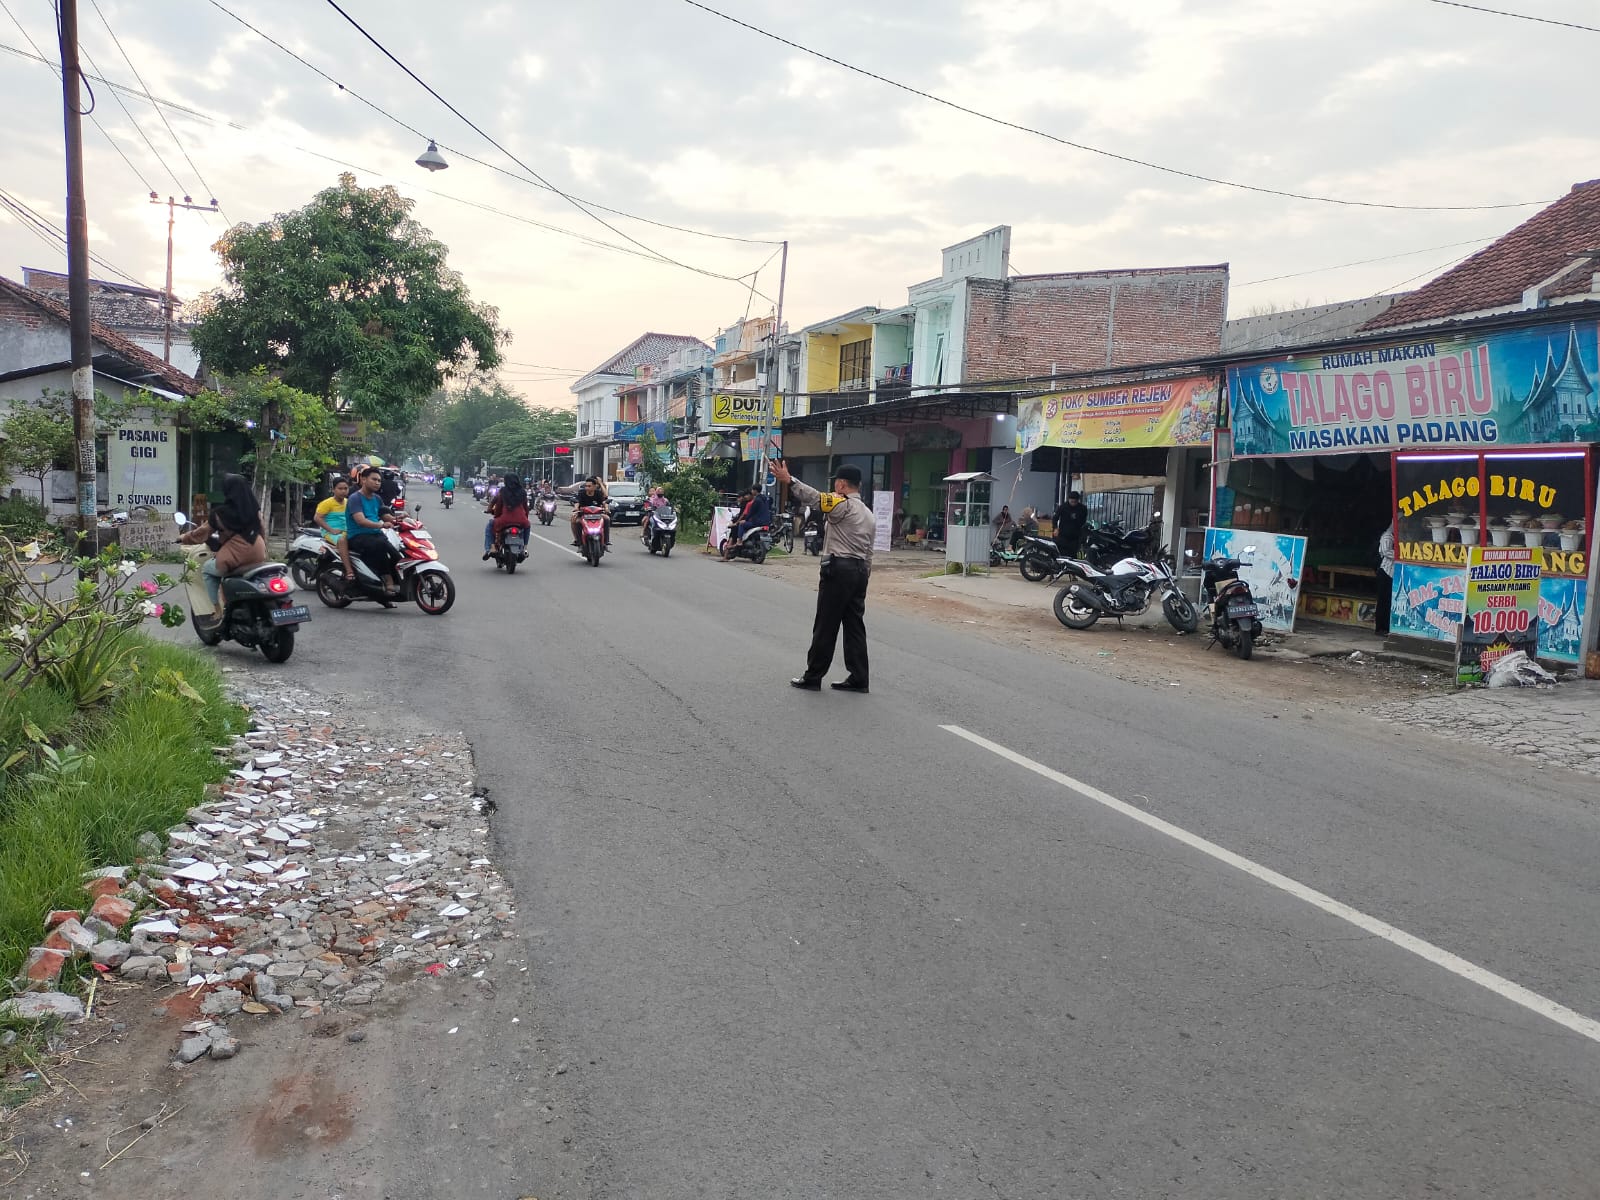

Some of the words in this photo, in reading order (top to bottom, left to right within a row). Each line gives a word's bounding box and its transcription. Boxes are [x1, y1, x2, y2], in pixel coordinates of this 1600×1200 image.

[1322, 350, 1374, 370] RUMAH
[1378, 343, 1436, 363] MAKAN
[1060, 396, 1083, 410] TOKO
[1086, 388, 1129, 408] SUMBER
[1132, 384, 1173, 404] REJEKI
[1281, 369, 1396, 428] TALAGO
[1405, 344, 1494, 418] BIRU
[119, 429, 168, 443] PASANG
[1289, 424, 1390, 451] MASAKAN
[1396, 419, 1498, 443] PADANG
[130, 446, 157, 458] GIGI
[128, 494, 172, 505] SUWARIS
[1398, 476, 1480, 517] TALAGO
[1489, 475, 1557, 509] BIRU
[1398, 542, 1469, 564] MASAKA
[1541, 552, 1585, 574] ANG
[1484, 550, 1507, 560] RUMAH
[1507, 549, 1531, 560] MAKAN
[1470, 564, 1513, 580] TALAGO
[1513, 563, 1540, 579] BIRU
[1477, 583, 1507, 592] MASAKAN
[1507, 582, 1531, 591] PADANG
[1438, 598, 1464, 612] SER
[1487, 595, 1517, 608] SERBA
[1538, 595, 1562, 626] RU
[1425, 607, 1458, 636] MASA
[1473, 609, 1529, 633] 10.000
